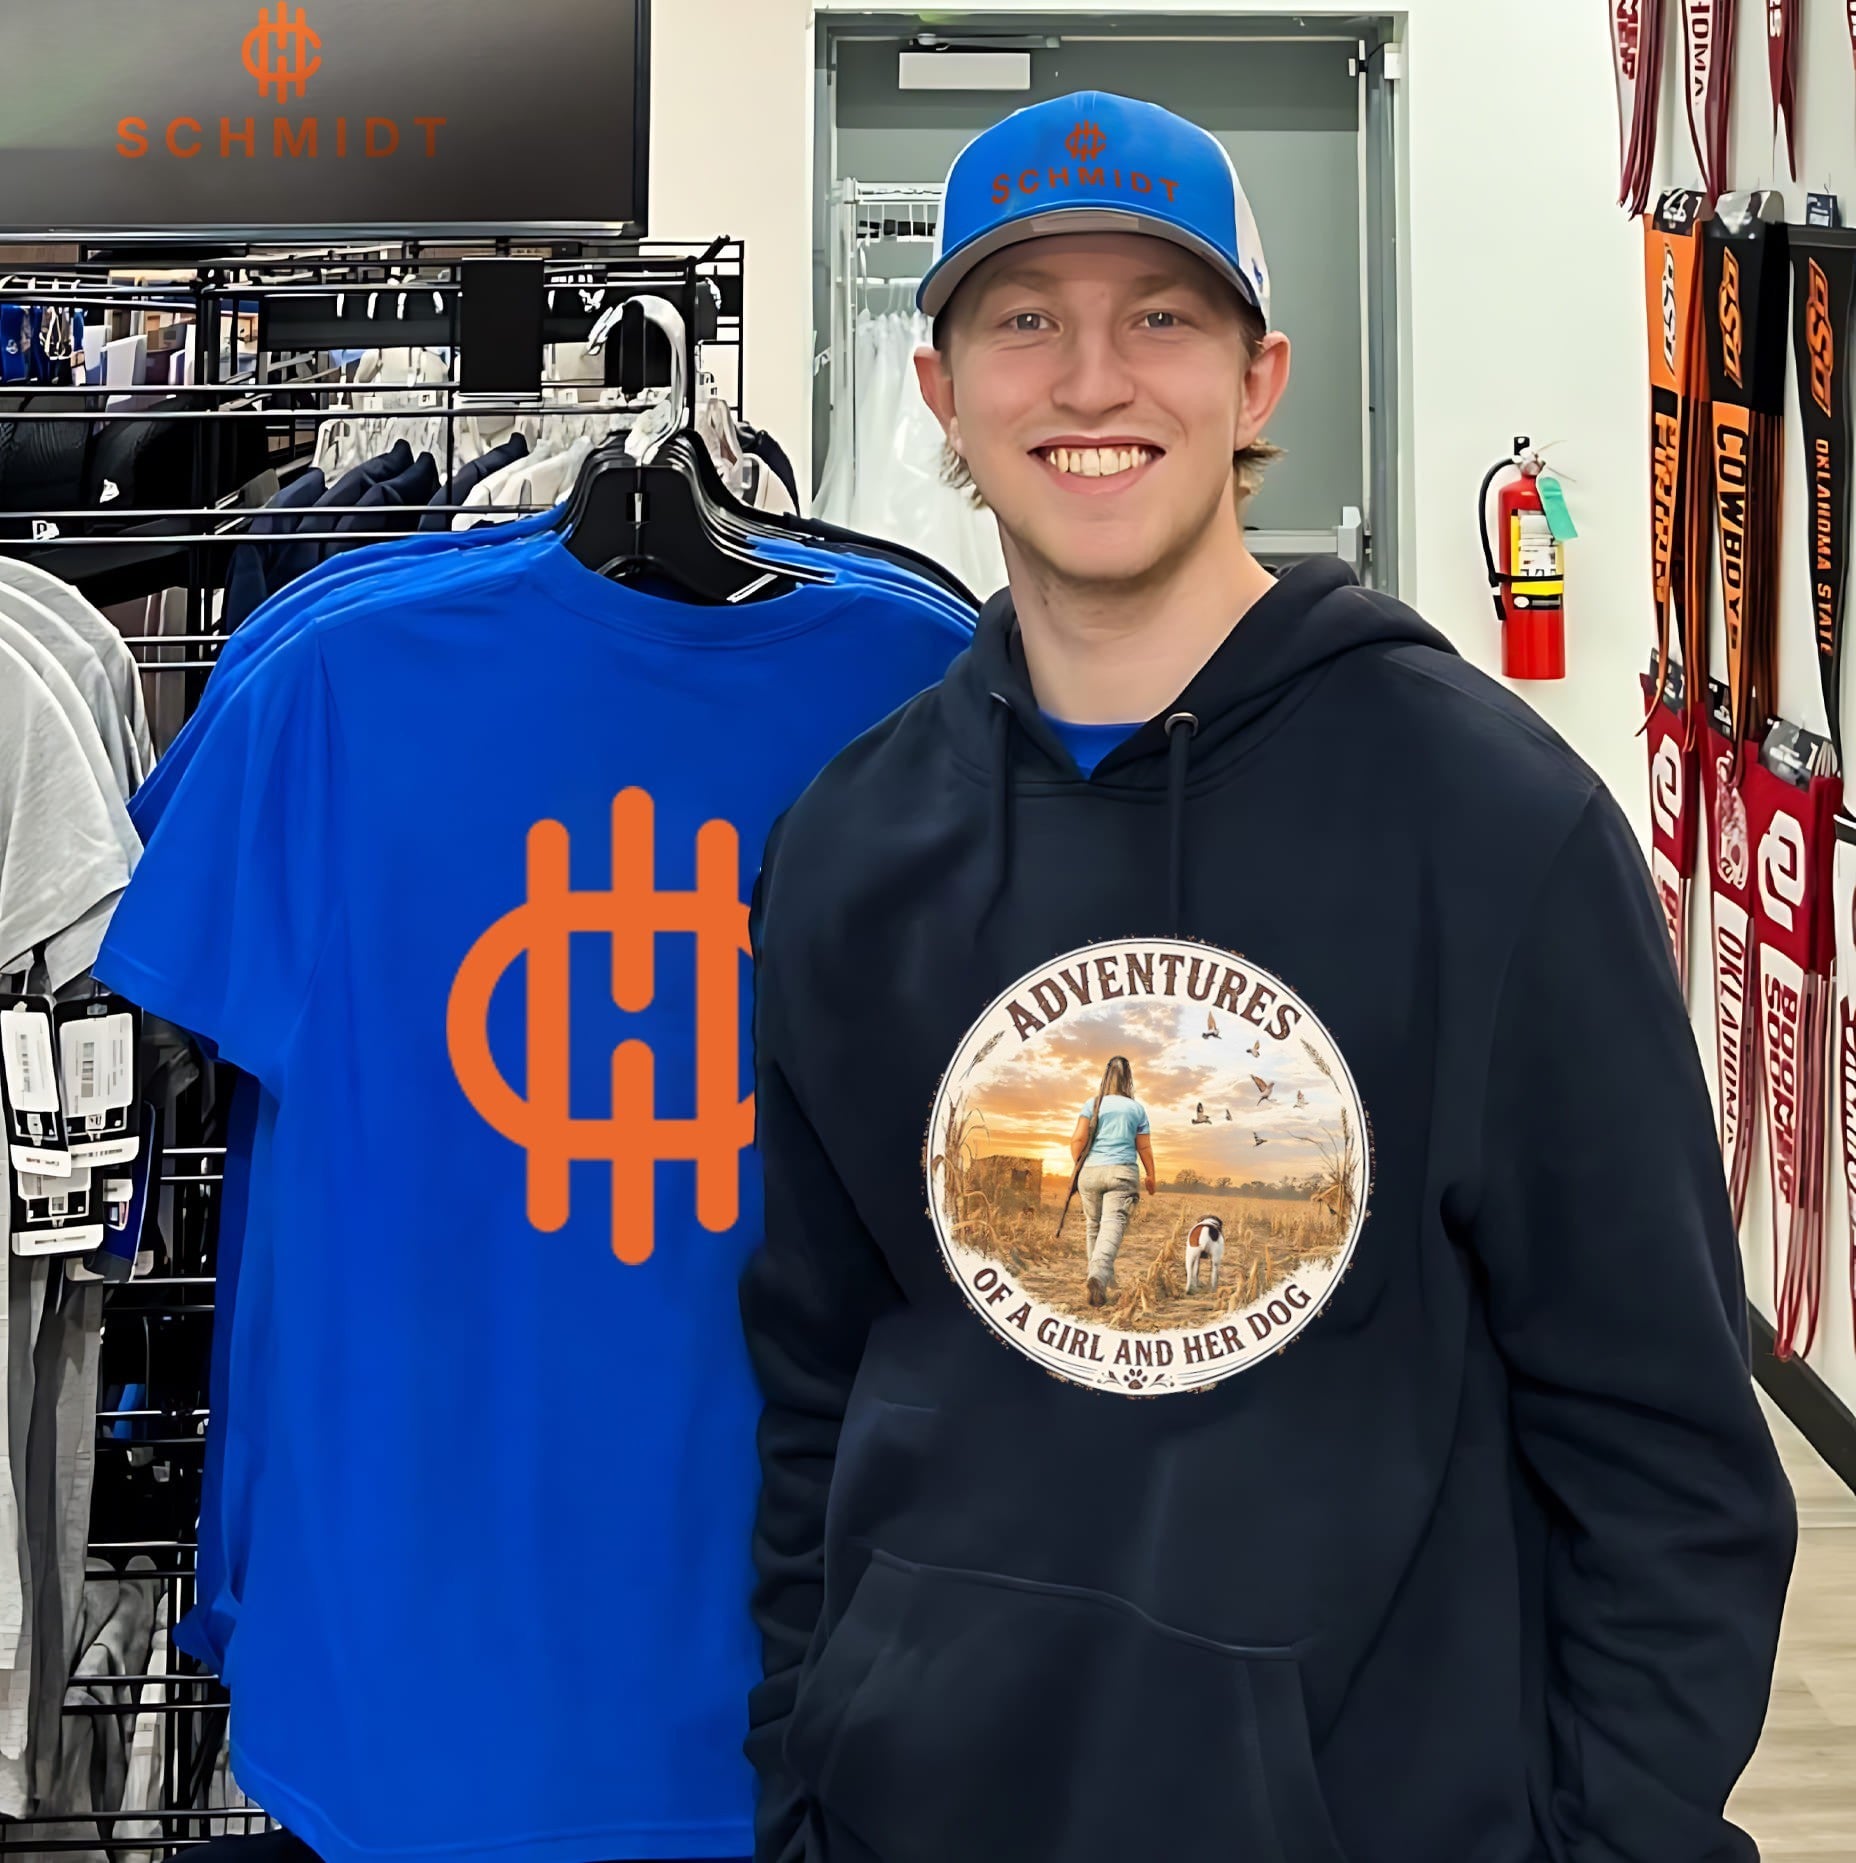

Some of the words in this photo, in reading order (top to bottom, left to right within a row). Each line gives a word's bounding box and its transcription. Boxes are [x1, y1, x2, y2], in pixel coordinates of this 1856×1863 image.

[116, 117, 447, 158] SCHMIDT
[991, 167, 1179, 205] SCHMIDT
[1814, 438, 1832, 570] OKLAHOMA
[1004, 952, 1303, 1042] ADVENTURES
[1718, 926, 1744, 1144] OKLAHOMA
[972, 1267, 1014, 1305] OF
[1006, 1298, 1031, 1331] A
[1037, 1316, 1105, 1363] GIRL
[1113, 1338, 1174, 1367] AND
[1182, 1324, 1246, 1365] HER
[1246, 1283, 1312, 1341] DOG
